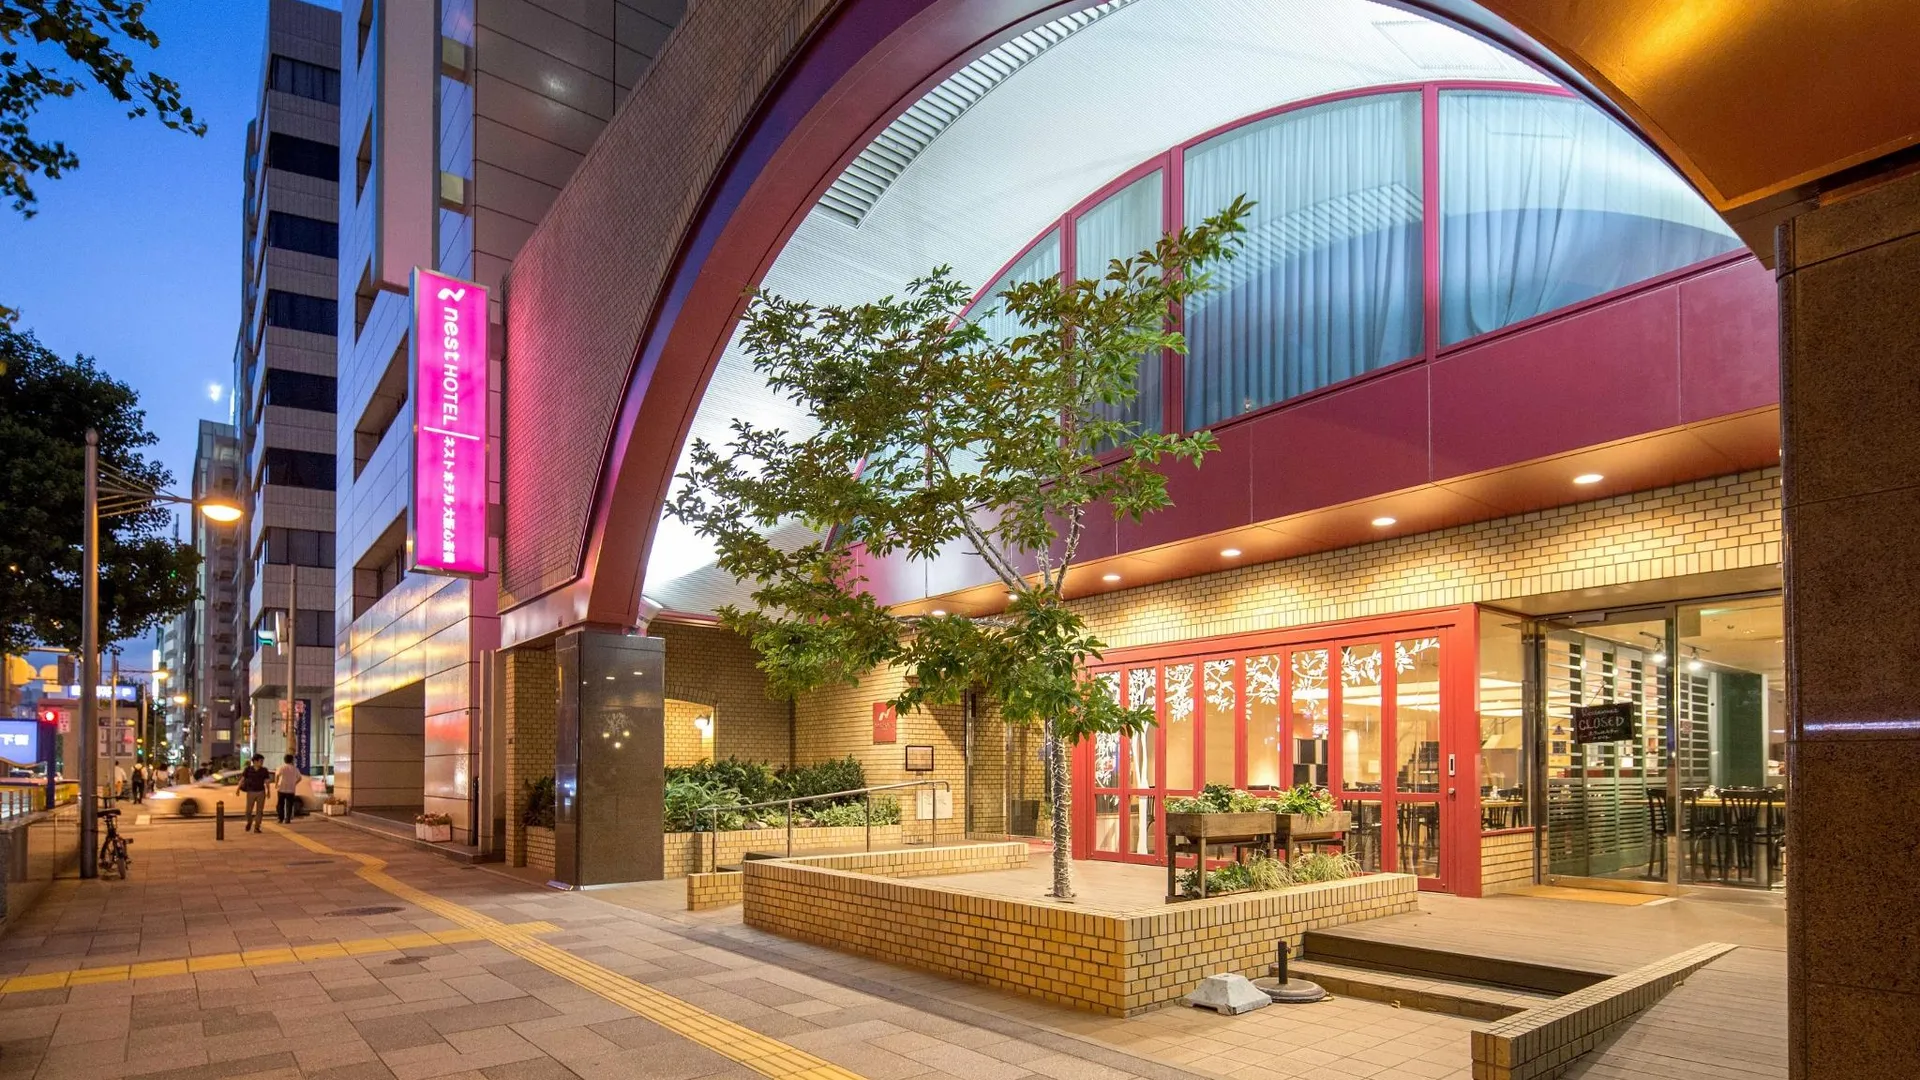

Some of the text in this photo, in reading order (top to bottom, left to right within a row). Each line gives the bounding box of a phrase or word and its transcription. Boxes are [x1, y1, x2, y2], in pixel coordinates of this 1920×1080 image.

[443, 306, 460, 426] nest HOTEL
[442, 435, 456, 563] ネストホテル大心
[1578, 716, 1624, 730] CLOSED
